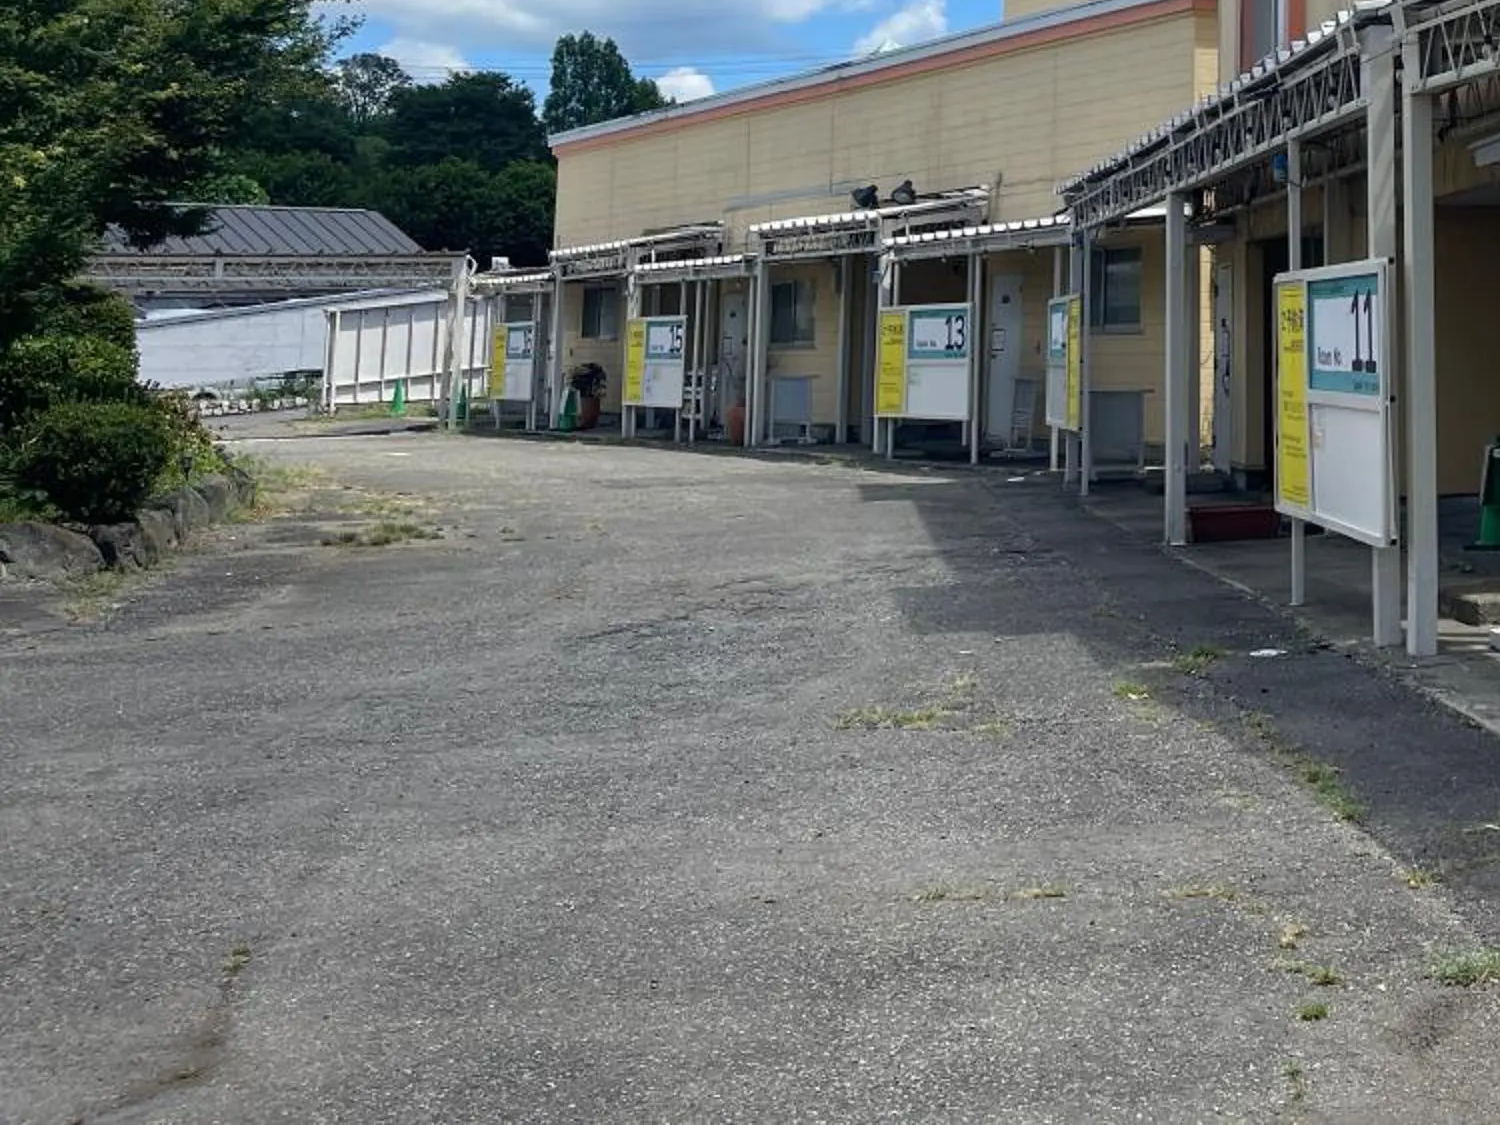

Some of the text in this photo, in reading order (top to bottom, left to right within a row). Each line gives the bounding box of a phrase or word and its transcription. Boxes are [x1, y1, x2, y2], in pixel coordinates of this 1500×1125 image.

[669, 324, 683, 353] 15
[944, 315, 966, 351] 13
[1351, 287, 1377, 374] 11
